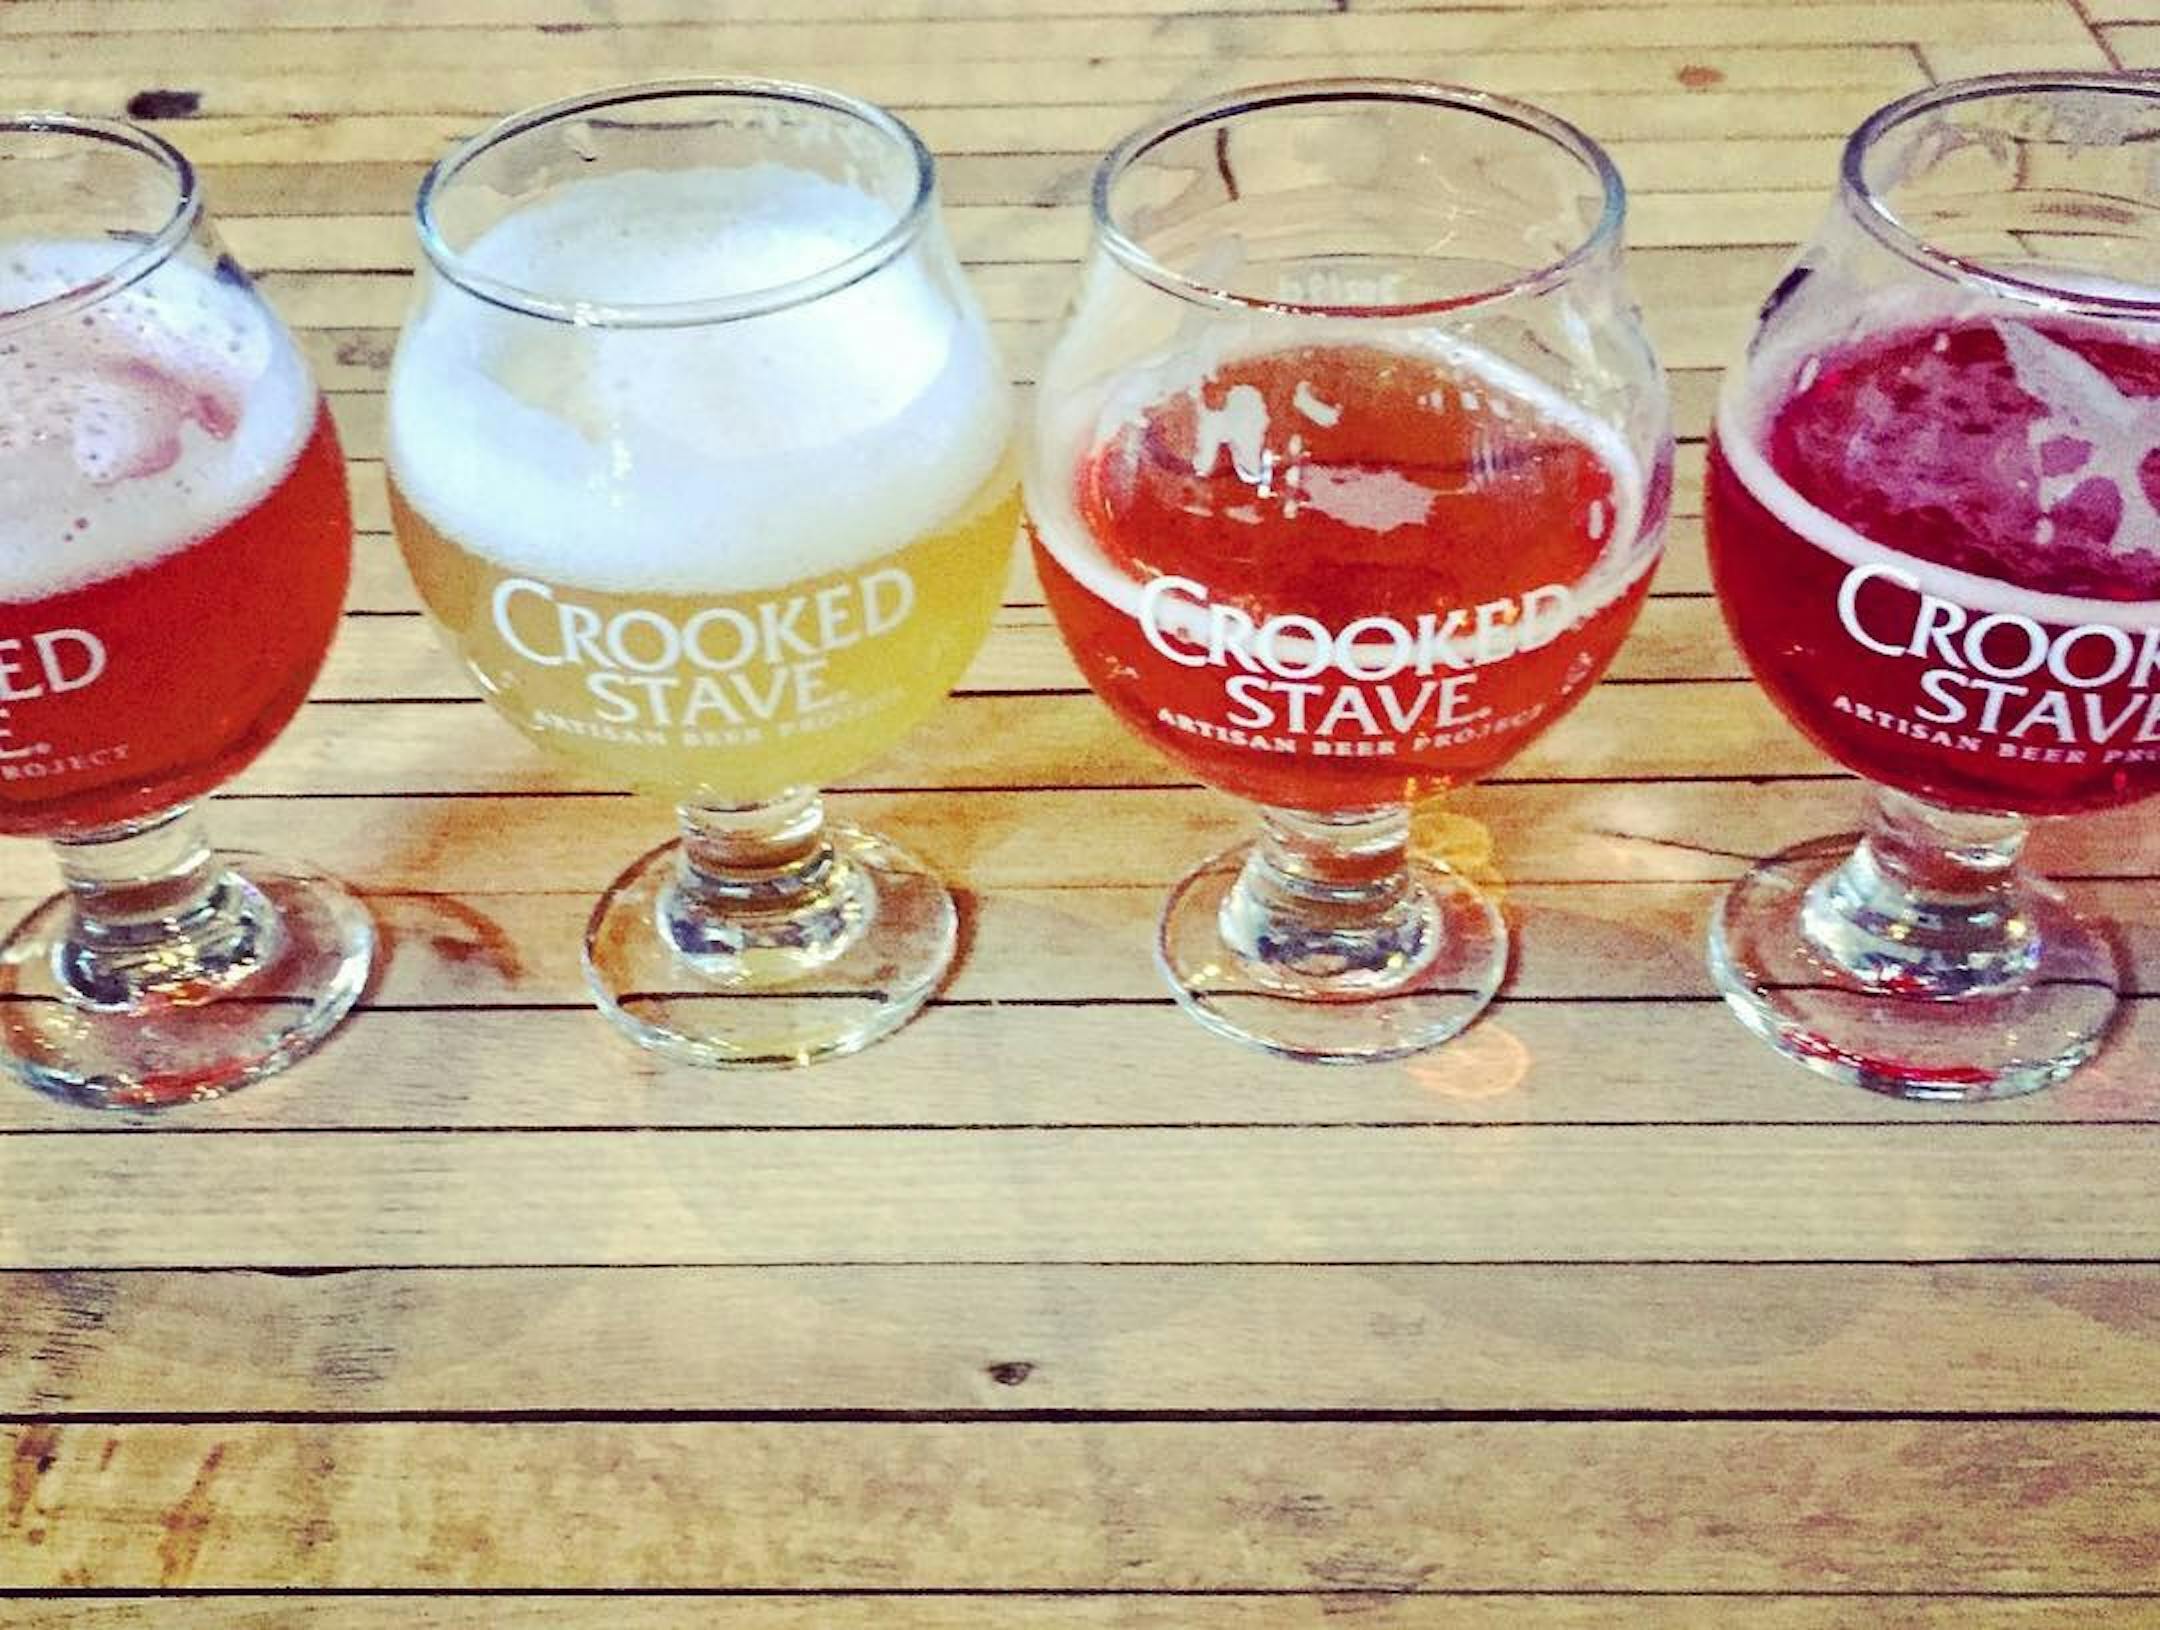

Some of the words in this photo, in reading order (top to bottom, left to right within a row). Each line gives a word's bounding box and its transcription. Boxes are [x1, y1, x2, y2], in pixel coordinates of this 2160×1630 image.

[492, 568, 916, 674] CROOKED
[1138, 575, 1571, 682] CROOKED
[586, 656, 844, 727] STAVE
[1224, 673, 1490, 737] STAVE
[1157, 707, 1297, 754] ARTISAN
[1312, 740, 1397, 758] BEER
[1833, 695, 1984, 752] ARTISAN
[1996, 742, 2089, 764] BEER
